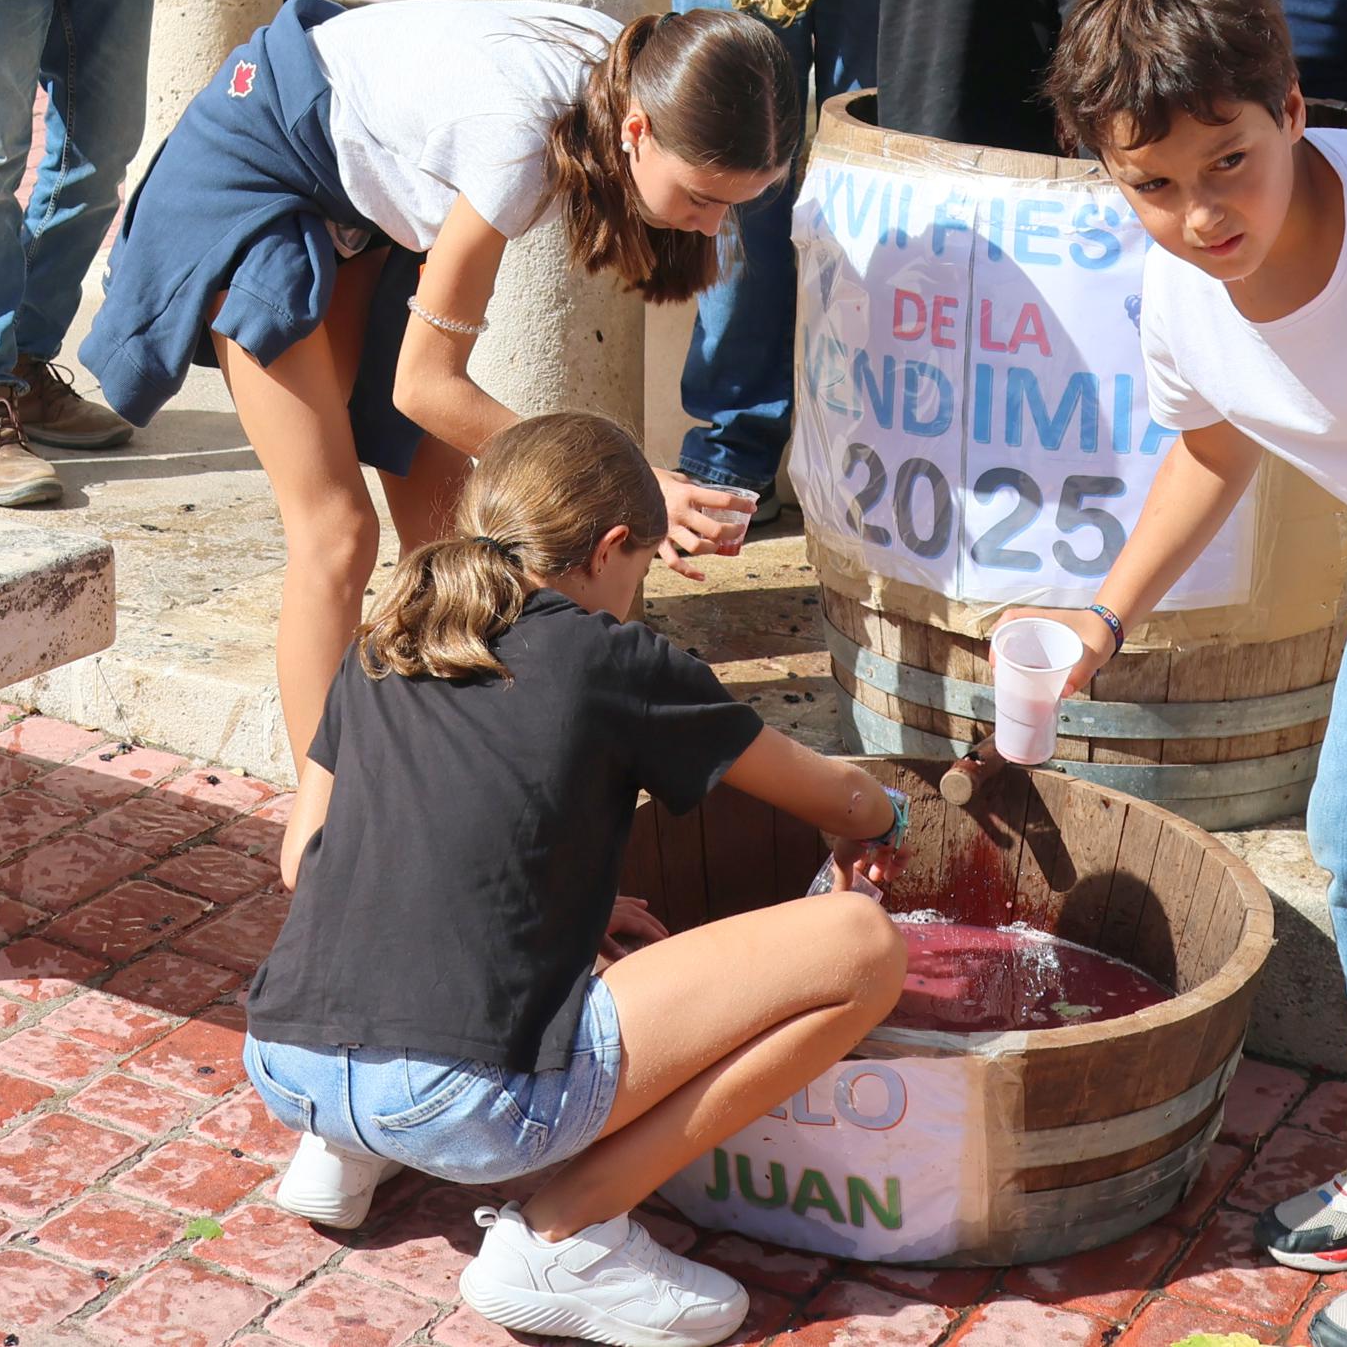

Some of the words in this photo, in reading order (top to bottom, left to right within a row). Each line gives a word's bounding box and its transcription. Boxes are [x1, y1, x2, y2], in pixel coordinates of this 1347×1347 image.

[812, 168, 914, 251] XVII
[930, 186, 1152, 271] FIES
[892, 288, 959, 350] DE
[979, 299, 1052, 358] LA
[840, 442, 1128, 580] 2025
[704, 1147, 903, 1230] JUAN
